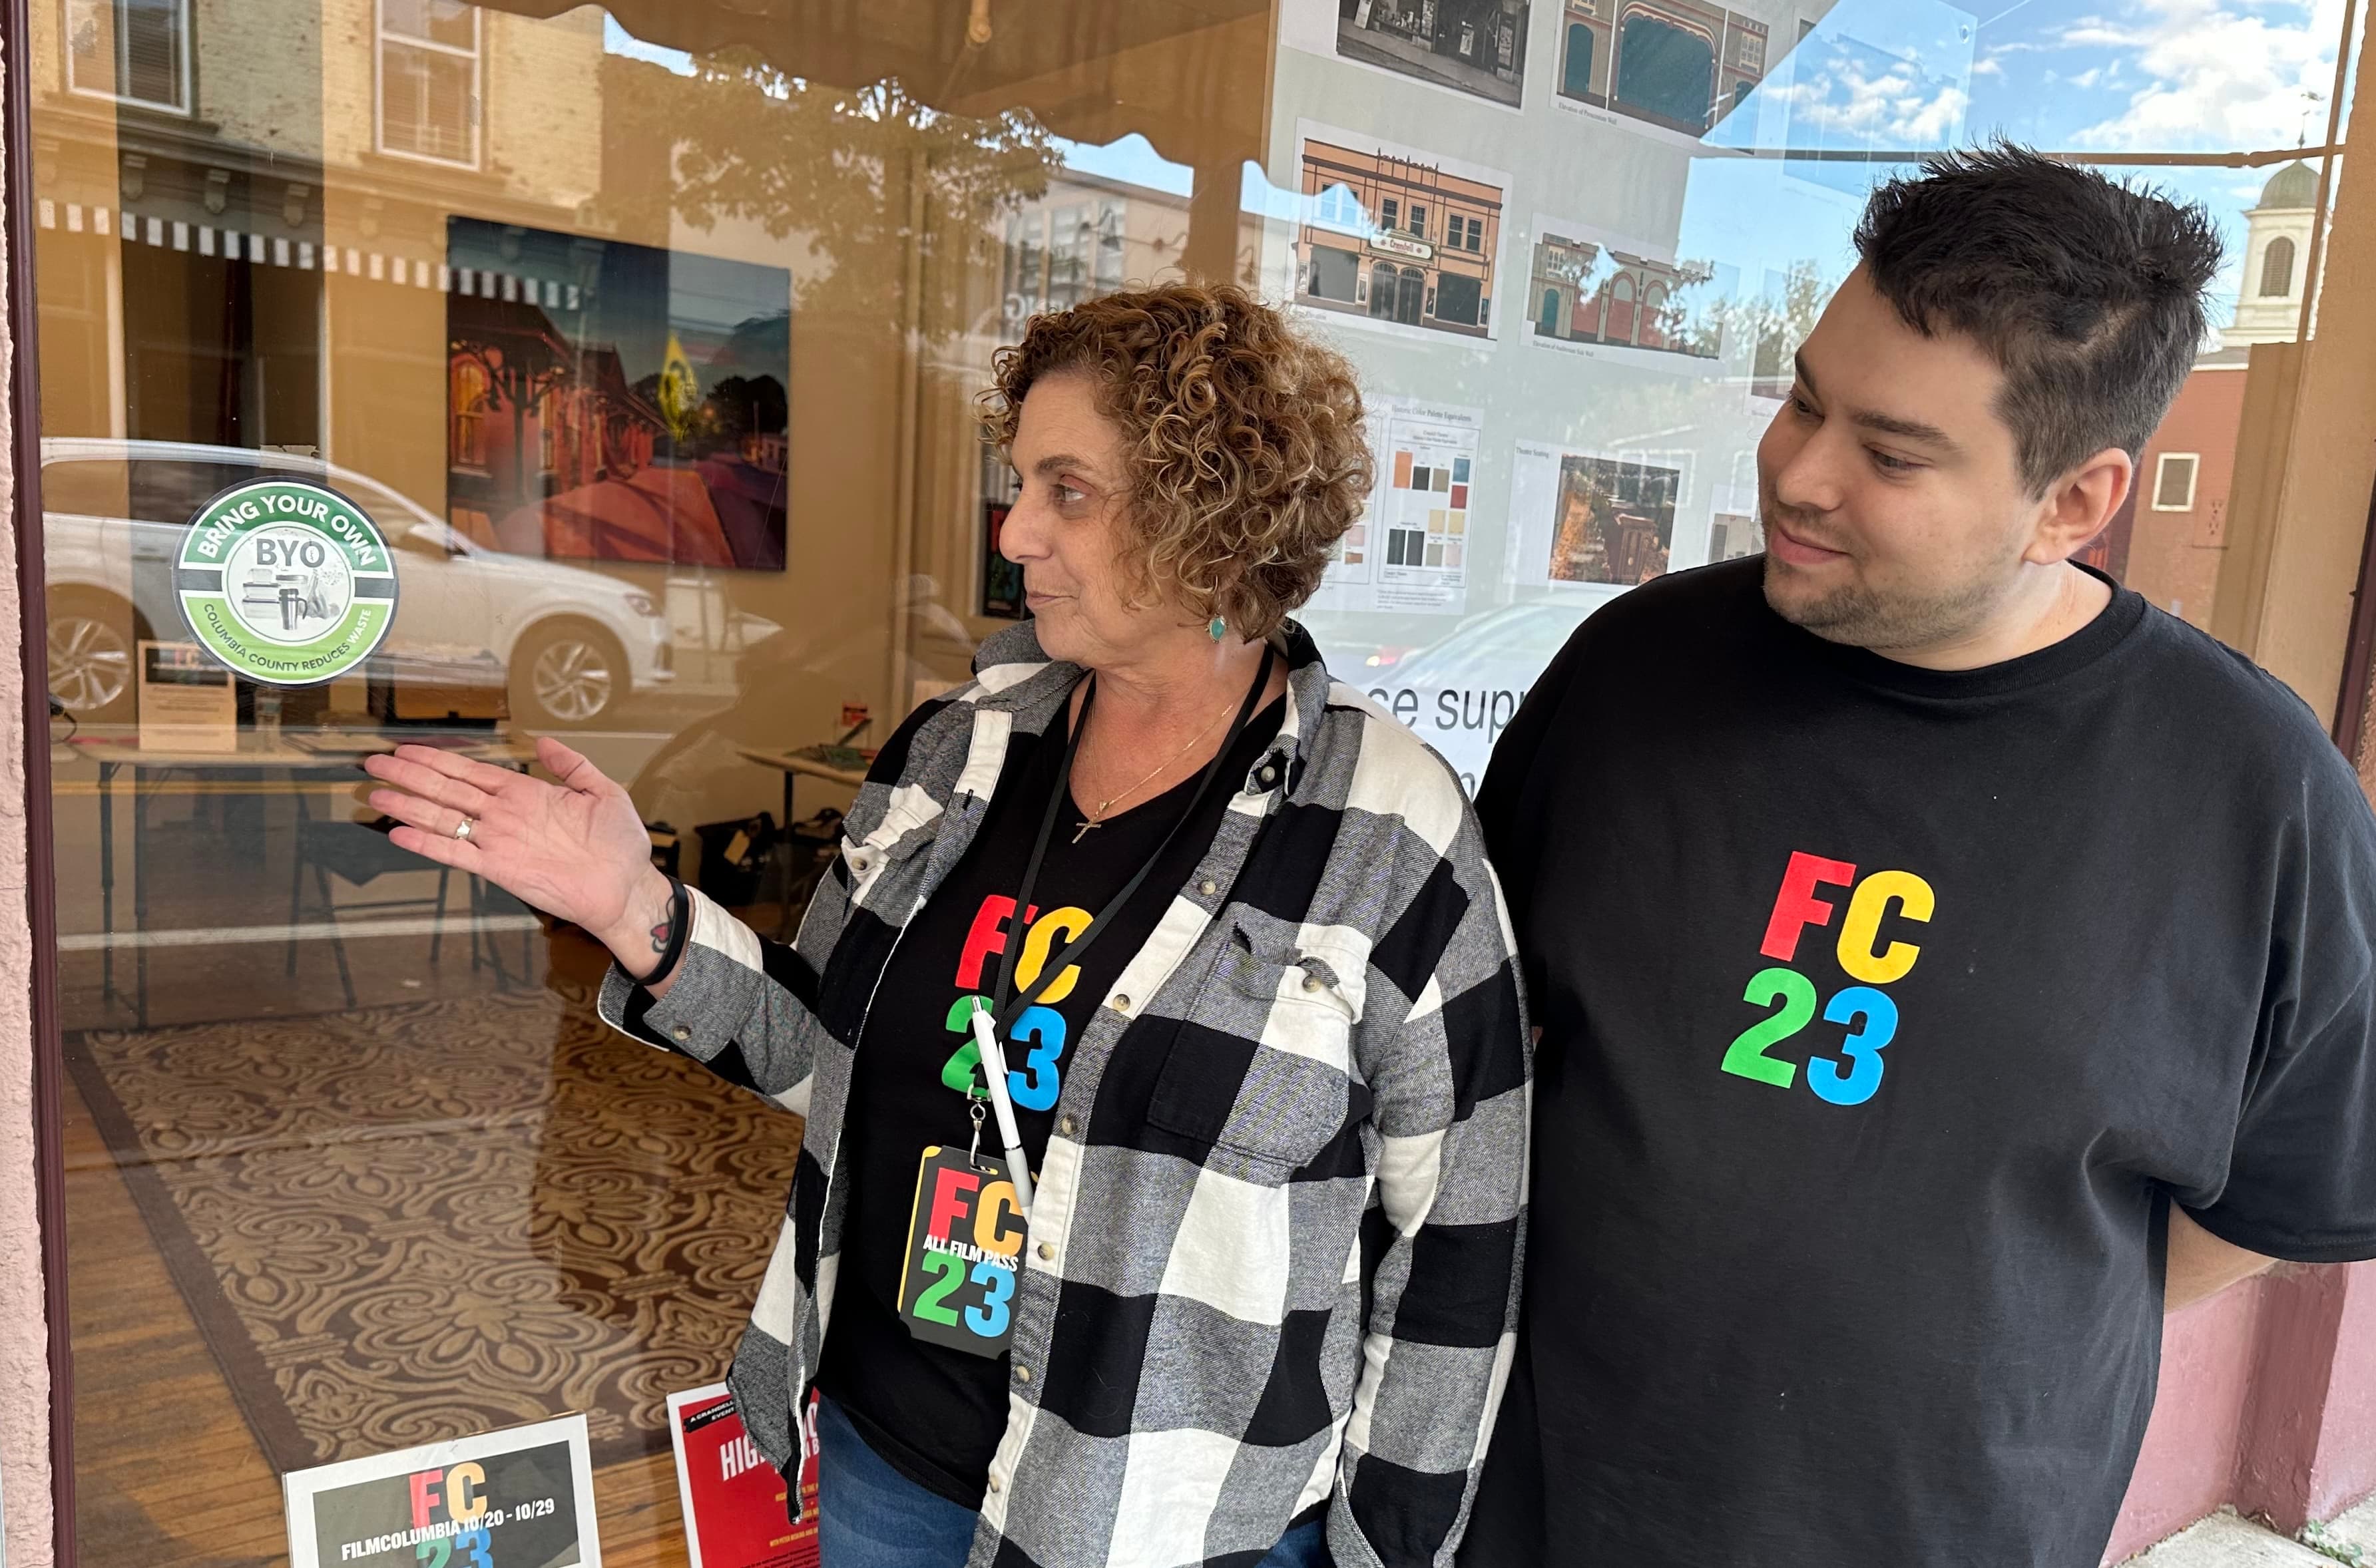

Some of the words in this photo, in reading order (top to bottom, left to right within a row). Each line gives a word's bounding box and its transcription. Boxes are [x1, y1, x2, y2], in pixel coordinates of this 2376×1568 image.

[197, 501, 260, 558] BRING
[260, 495, 329, 522] YOUR
[332, 515, 376, 566] OWN
[256, 538, 325, 568] BYO
[204, 604, 246, 658] COLUMBIA
[249, 653, 299, 671] COUNTY
[302, 643, 350, 670] REDUCES
[346, 609, 371, 644] WASTE
[1435, 689, 1524, 743] sup
[955, 894, 1094, 1004] FC
[1760, 851, 1935, 984] FC
[941, 995, 1067, 1111] 23
[1721, 967, 1899, 1105] 23
[928, 1167, 1024, 1257] FC
[923, 1235, 948, 1254] ALL
[949, 1240, 983, 1263] FILM
[983, 1251, 1019, 1272] PASS
[913, 1251, 1015, 1338] 23
[720, 1434, 778, 1482] HIG
[342, 1522, 461, 1561] FILMCOLUMBIA
[464, 1509, 505, 1533] 10/20
[515, 1497, 555, 1521] 10/29
[409, 1462, 487, 1531] FC
